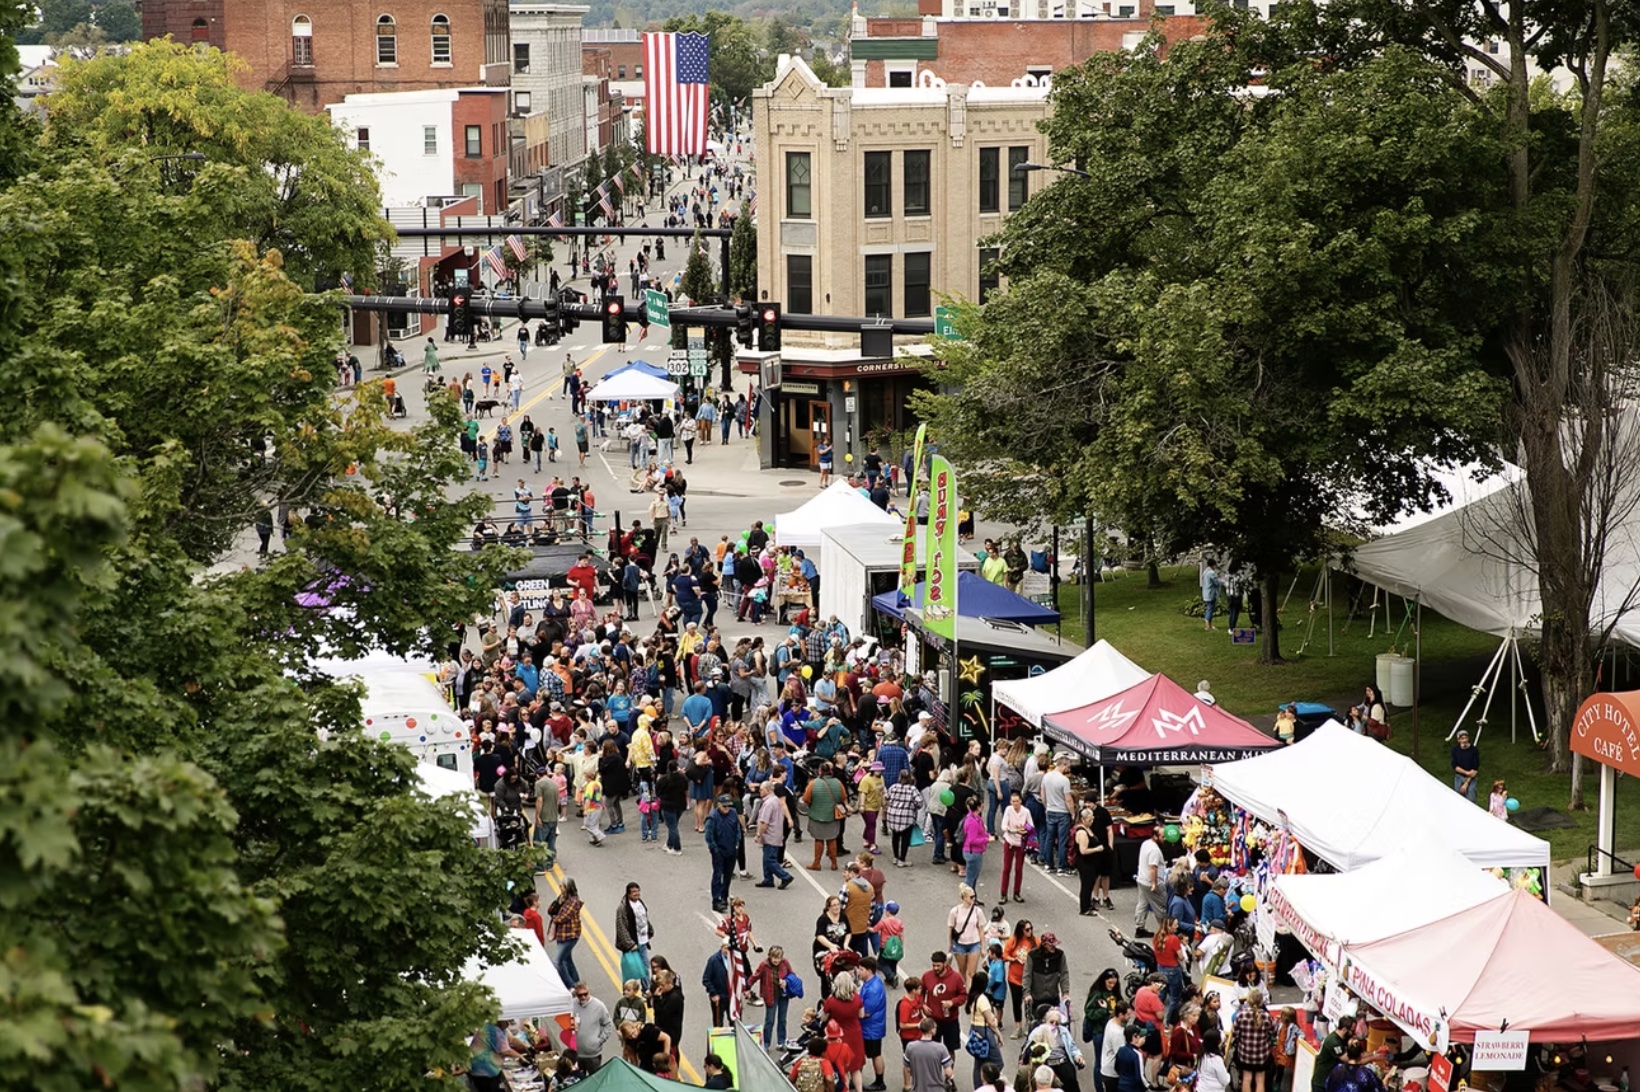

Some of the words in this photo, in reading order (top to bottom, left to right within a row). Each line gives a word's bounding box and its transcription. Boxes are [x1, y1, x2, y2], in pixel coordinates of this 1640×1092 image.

[669, 363, 688, 373] 302
[693, 365, 704, 375] 14
[515, 579, 549, 590] GREEN
[1577, 703, 1601, 737] CITY
[1604, 703, 1640, 760] HOTEL
[1594, 737, 1623, 762] CAFÉ
[1116, 752, 1236, 761] MEDITERRANEAN
[1377, 986, 1431, 1037] COLADAS
[1476, 1041, 1525, 1050] STRAWBERRY
[1475, 1052, 1524, 1060] LEMONADE
